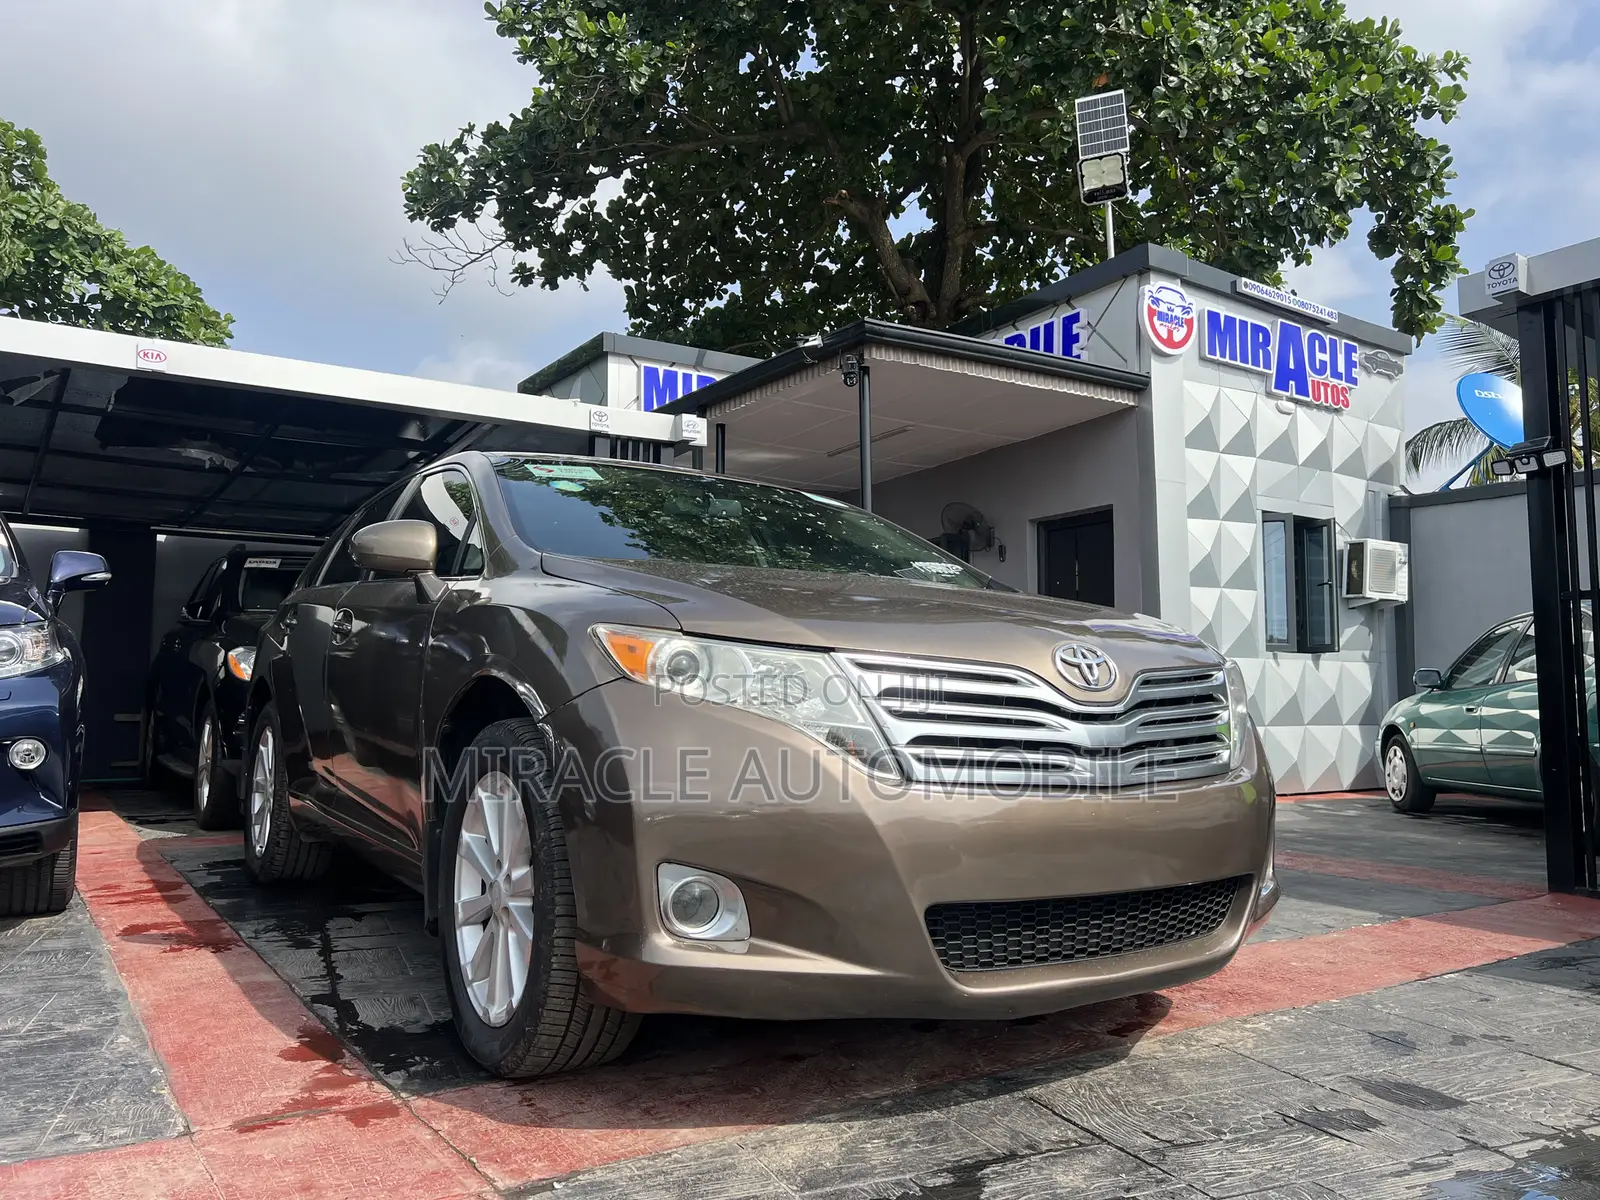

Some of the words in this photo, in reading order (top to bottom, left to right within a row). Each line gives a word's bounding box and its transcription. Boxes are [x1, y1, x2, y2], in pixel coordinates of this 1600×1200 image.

[1487, 277, 1518, 290] TOYOTA
[1248, 282, 1292, 304] 09064629015
[1297, 300, 1338, 320] 08075241483
[1157, 310, 1185, 328] MIRACLE
[143, 351, 162, 361] KIA
[1206, 309, 1359, 398] MIRACLE
[591, 421, 610, 429] TOYOTA
